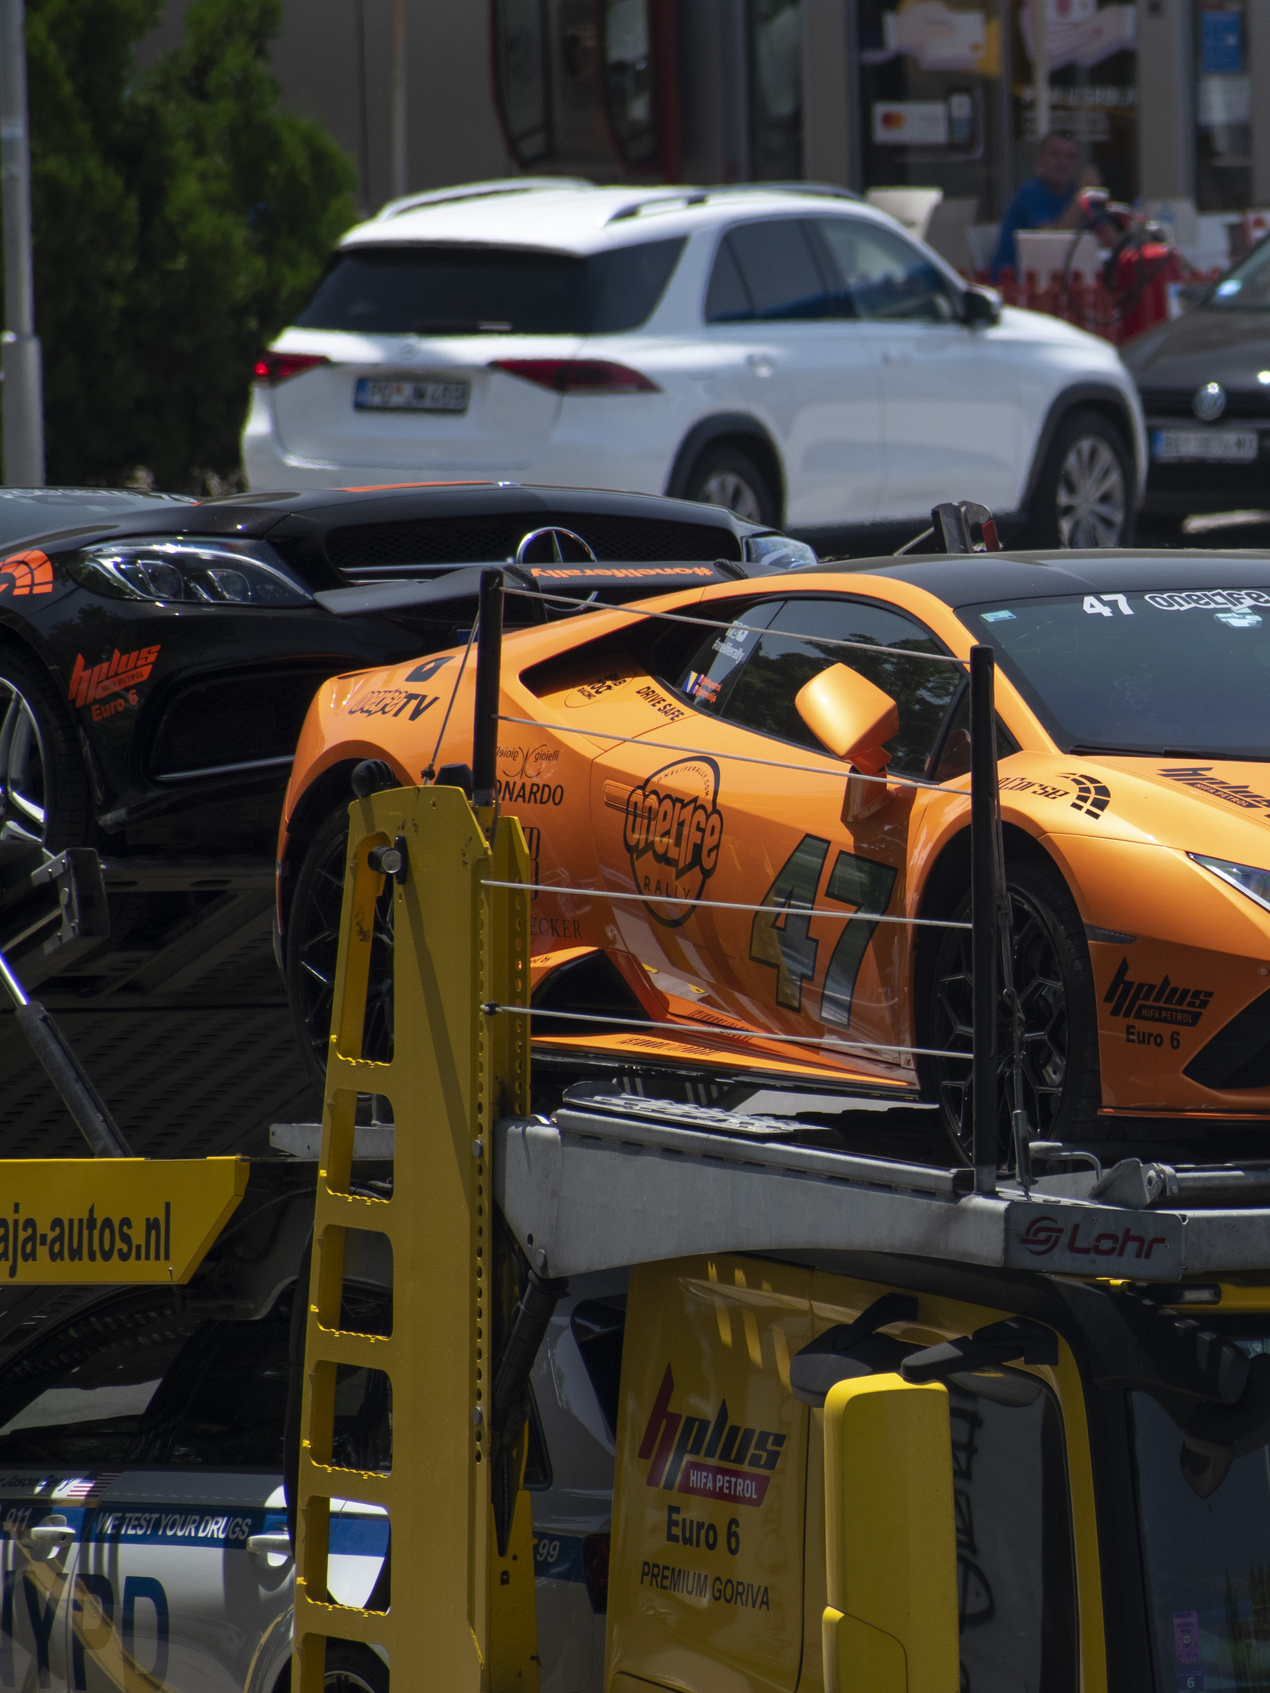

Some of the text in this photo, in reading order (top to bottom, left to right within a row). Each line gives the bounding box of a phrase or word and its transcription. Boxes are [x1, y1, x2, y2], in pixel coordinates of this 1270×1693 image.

[530, 567, 714, 578] #oneliferally
[1083, 594, 1135, 617] 47
[68, 644, 161, 708] hplus
[91, 689, 138, 722] Euro 6
[635, 685, 685, 721] DRIVE SAFE
[1215, 791, 1249, 807] PETROL
[643, 875, 691, 900] RALLY
[749, 833, 898, 1030] 47
[1103, 955, 1214, 1018] hplus
[1141, 1008, 1193, 1023] HIFA PETROL
[1126, 1024, 1181, 1049] Euro 6
[1068, 1223, 1166, 1259] Lohr
[637, 1361, 786, 1490] hplus
[689, 1469, 758, 1499] HIFA PETROL
[3, 1508, 33, 1532] 911
[96, 1512, 252, 1540] WE TEST YOUR DRUGS
[666, 1504, 740, 1556] Euro 6
[640, 1560, 770, 1611] PREMIUM GORIVA
[1187, 1677, 1195, 1689] 6
